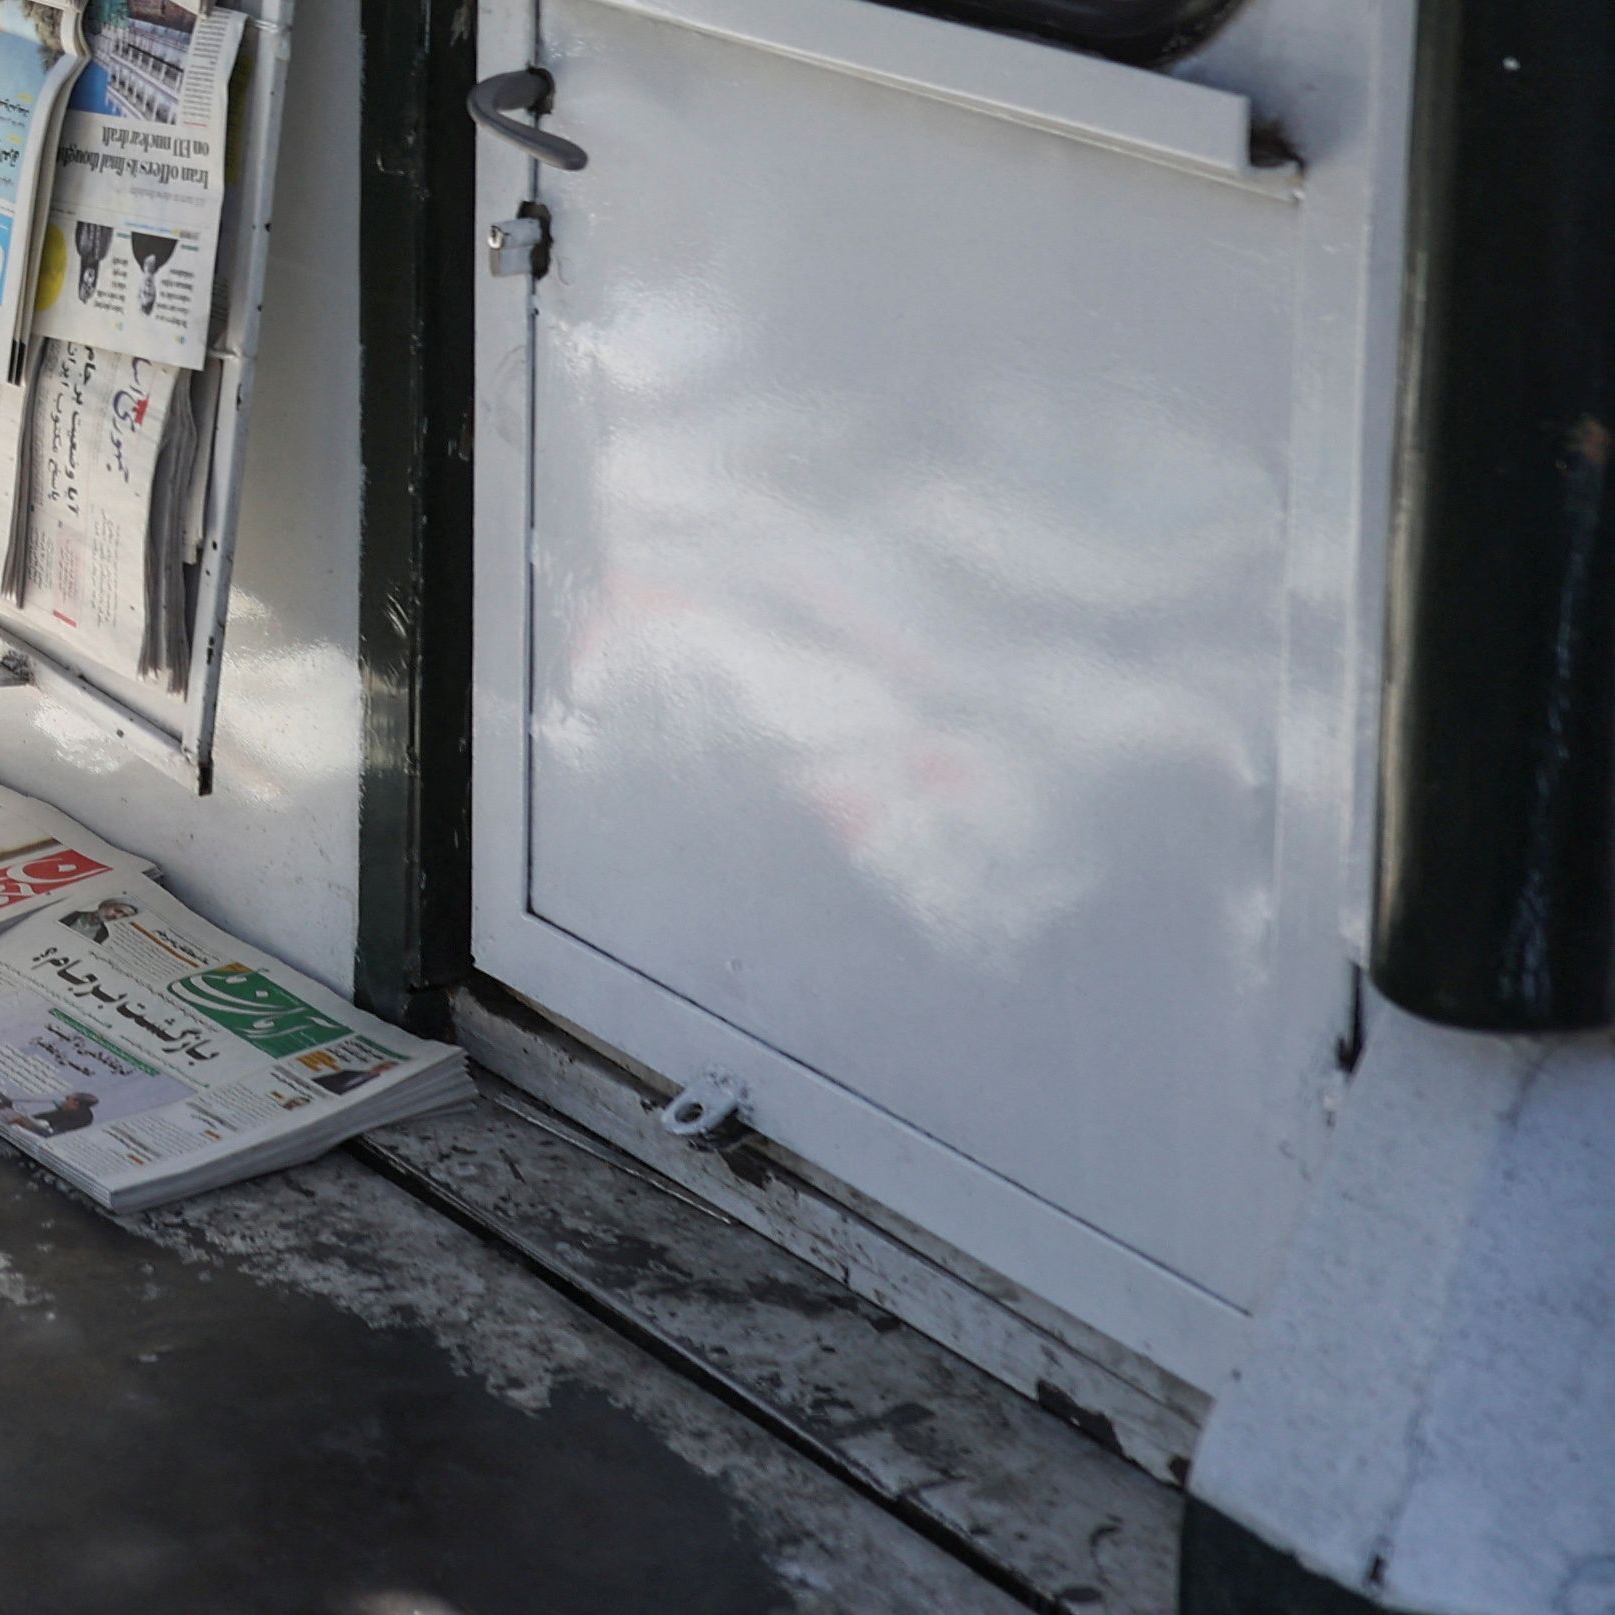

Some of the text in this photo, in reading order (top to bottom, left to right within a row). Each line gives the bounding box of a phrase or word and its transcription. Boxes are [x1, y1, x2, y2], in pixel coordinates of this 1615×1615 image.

[100, 153, 208, 188] Iran offers its final
[101, 125, 210, 157] on EU nuclear draft
[44, 341, 78, 500] پاسخ مکتوب ایران
[63, 411, 84, 479] وضعیت
[31, 947, 127, 1017] برجام؟
[118, 1003, 221, 1064] بازگشت
